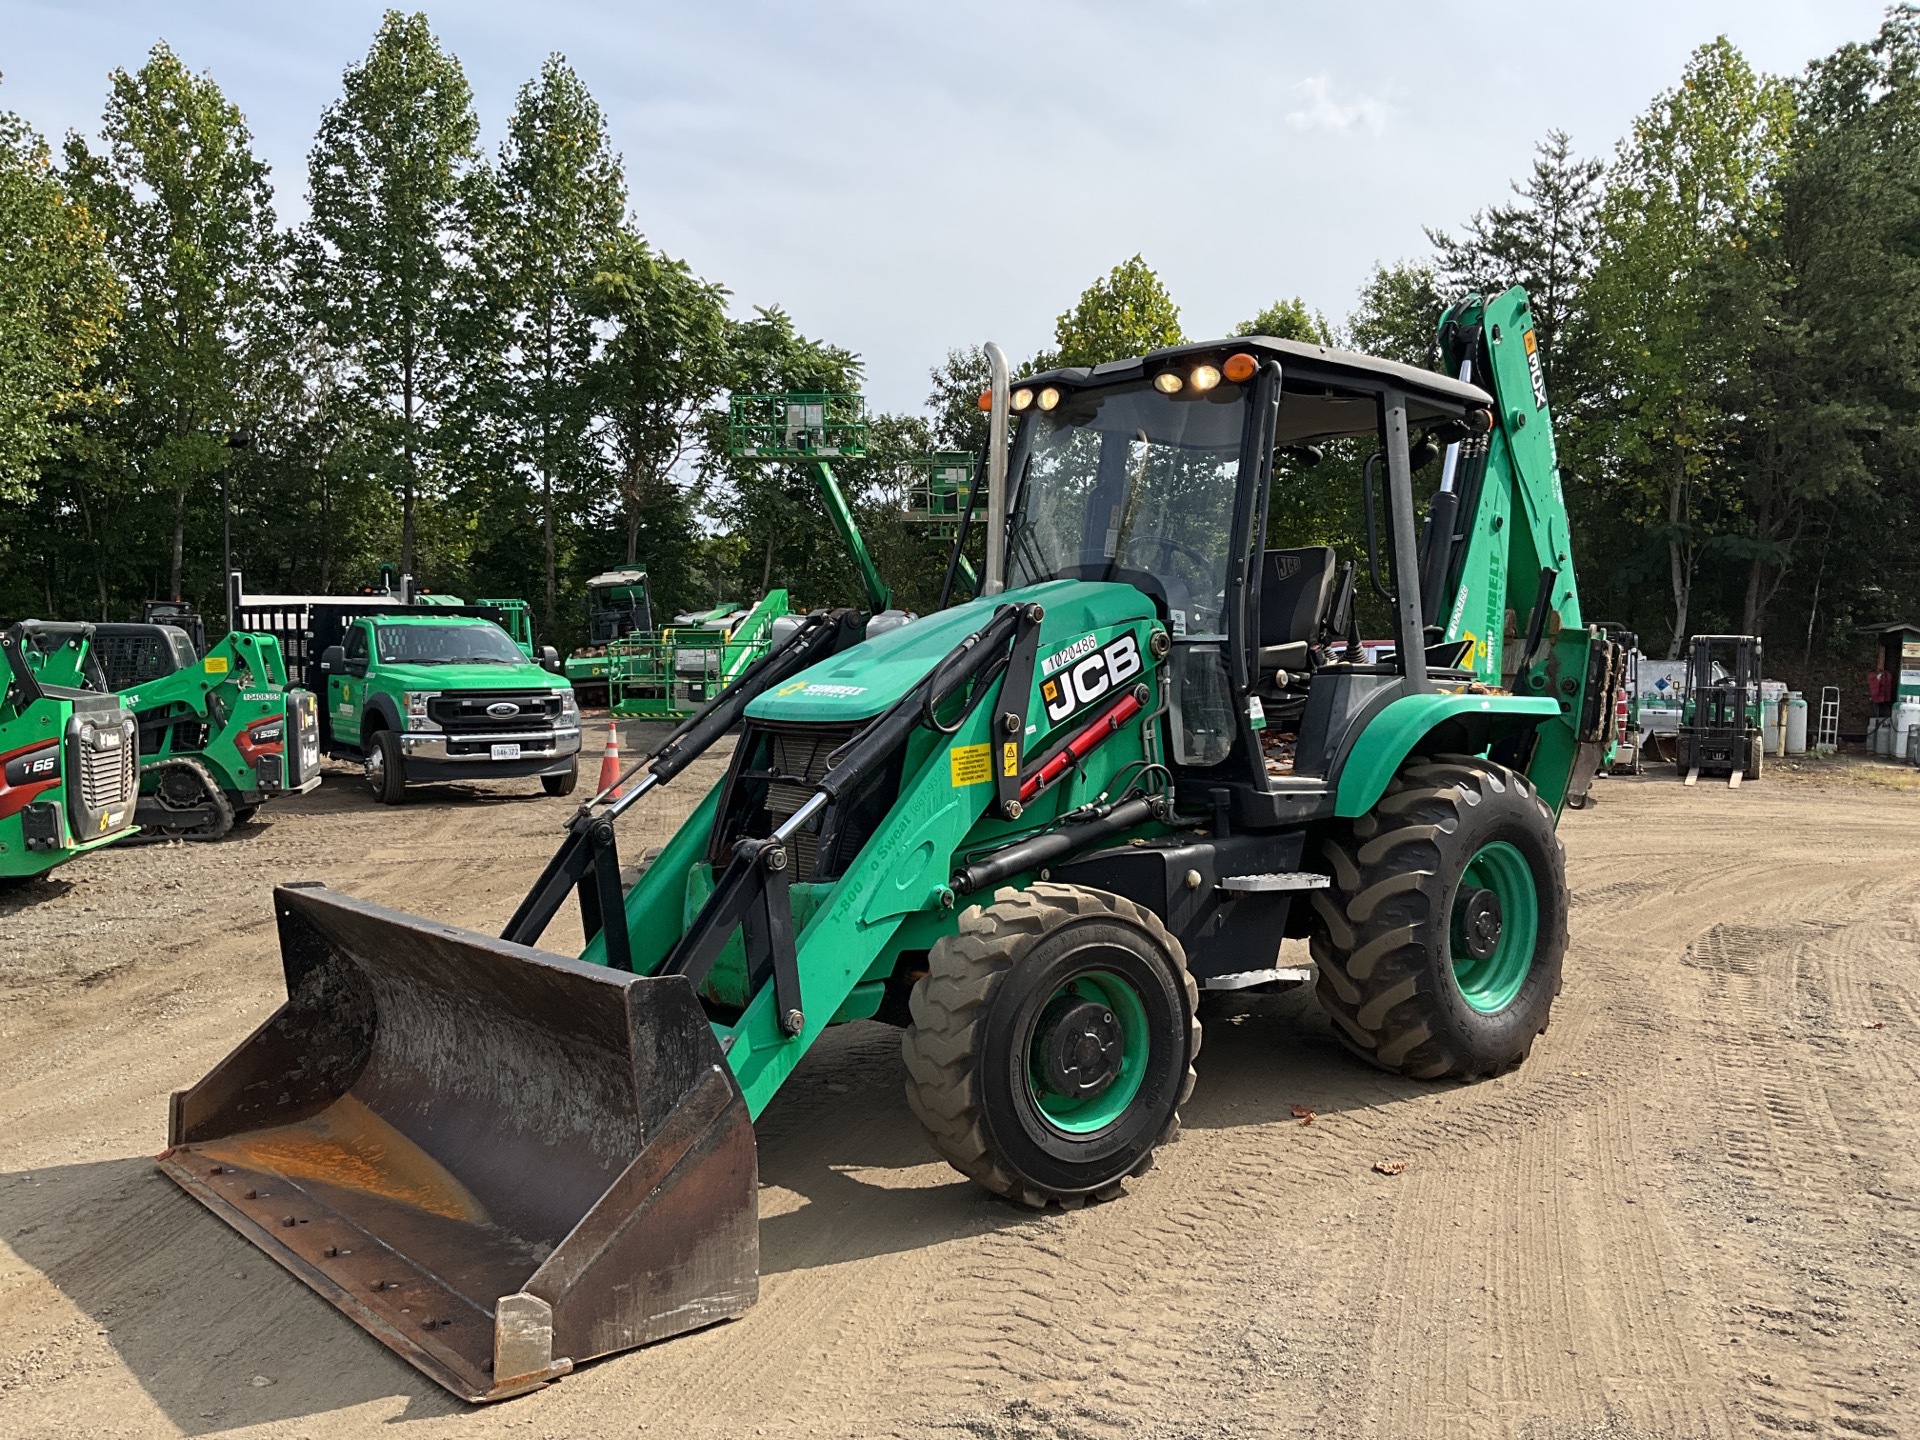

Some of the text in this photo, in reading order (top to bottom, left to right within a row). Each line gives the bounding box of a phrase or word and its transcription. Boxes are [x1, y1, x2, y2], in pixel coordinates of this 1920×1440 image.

[1528, 353, 1547, 409] 3CX
[1279, 557, 1299, 577] JCB
[1048, 634, 1096, 670] 1020486
[802, 684, 868, 696] SUNBELT
[1048, 636, 1140, 720] JCB
[22, 757, 55, 774] T66
[830, 881, 864, 924] 1-800
[877, 814, 912, 861] Sweat
